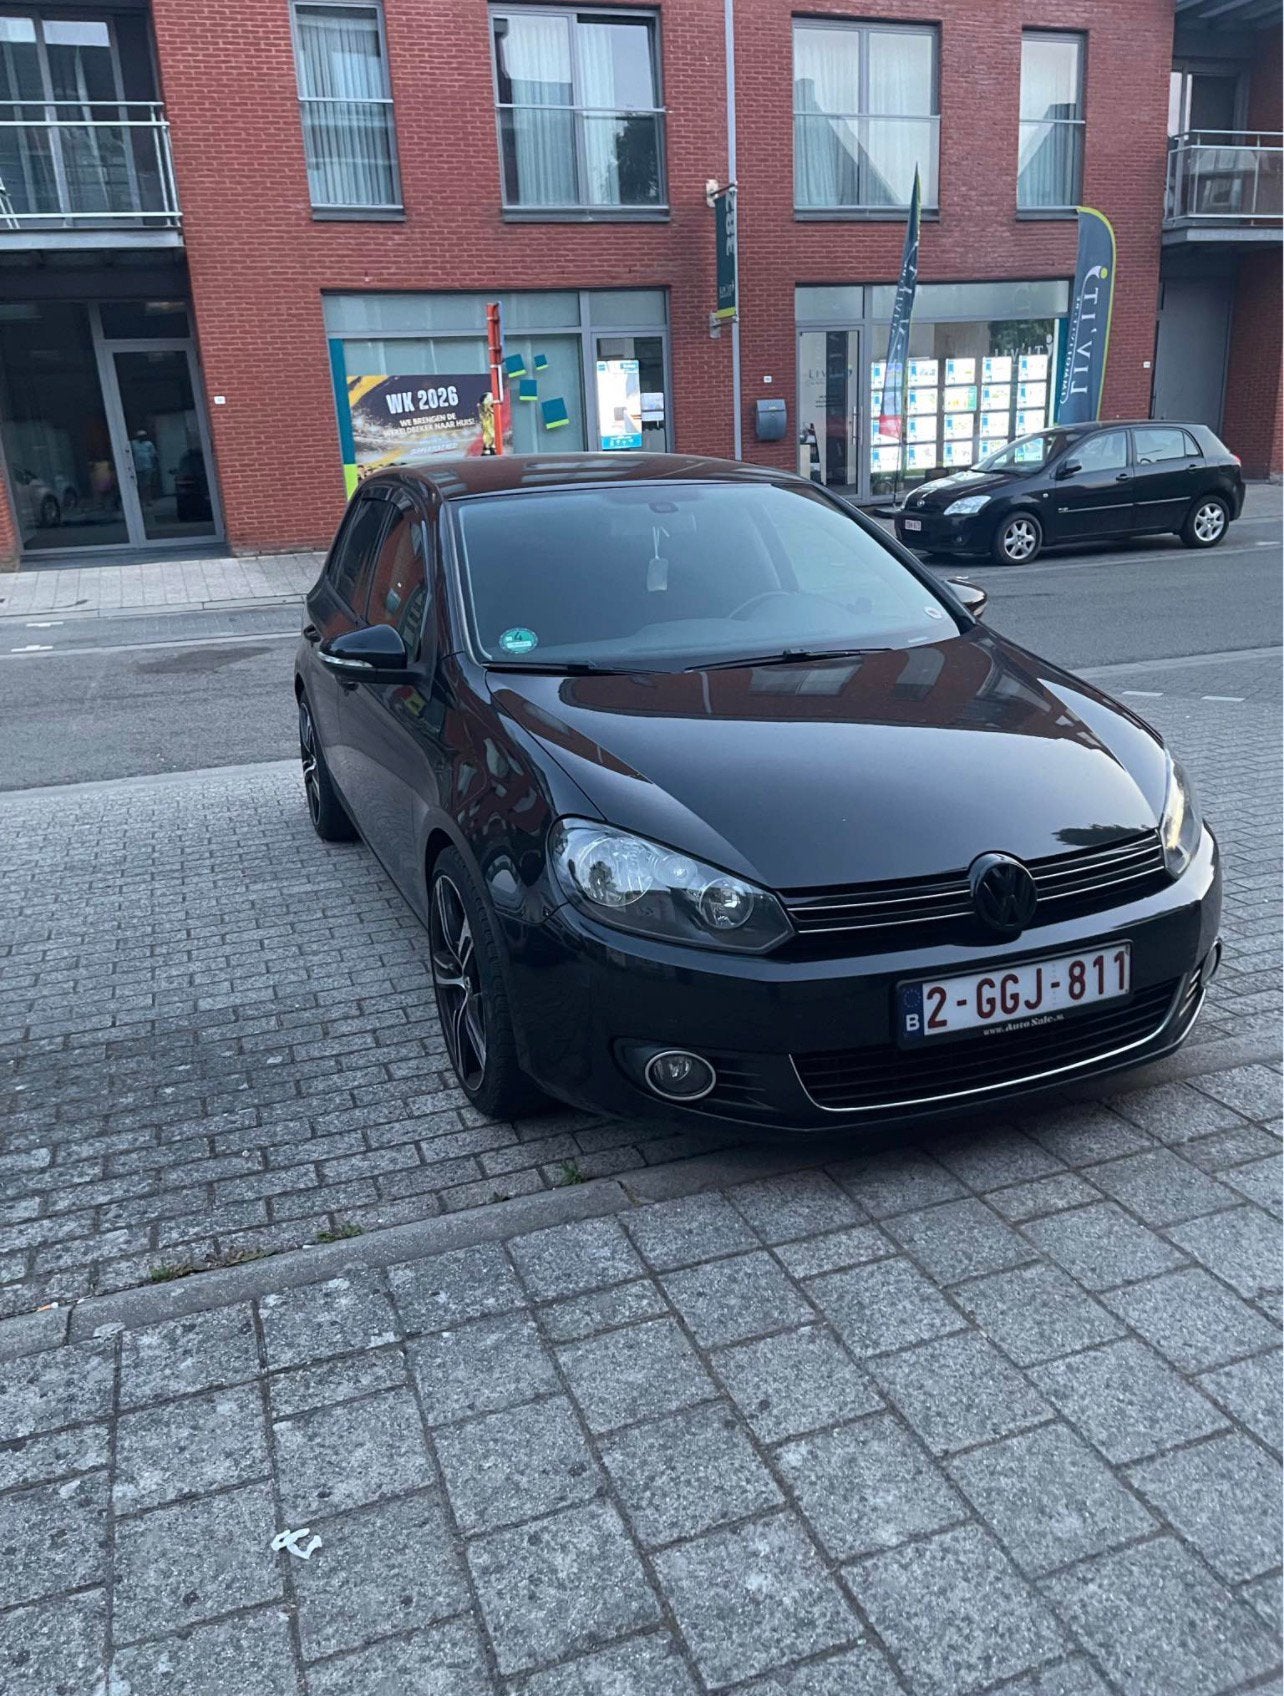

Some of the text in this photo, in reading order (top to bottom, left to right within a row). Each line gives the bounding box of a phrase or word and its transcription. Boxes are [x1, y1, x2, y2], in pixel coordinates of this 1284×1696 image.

[386, 385, 459, 414] WK 2026
[400, 412, 457, 427] WE BRENGEN DE
[435, 420, 456, 431] NAAR
[905, 950, 1126, 1032] B 2-GGJ-811
